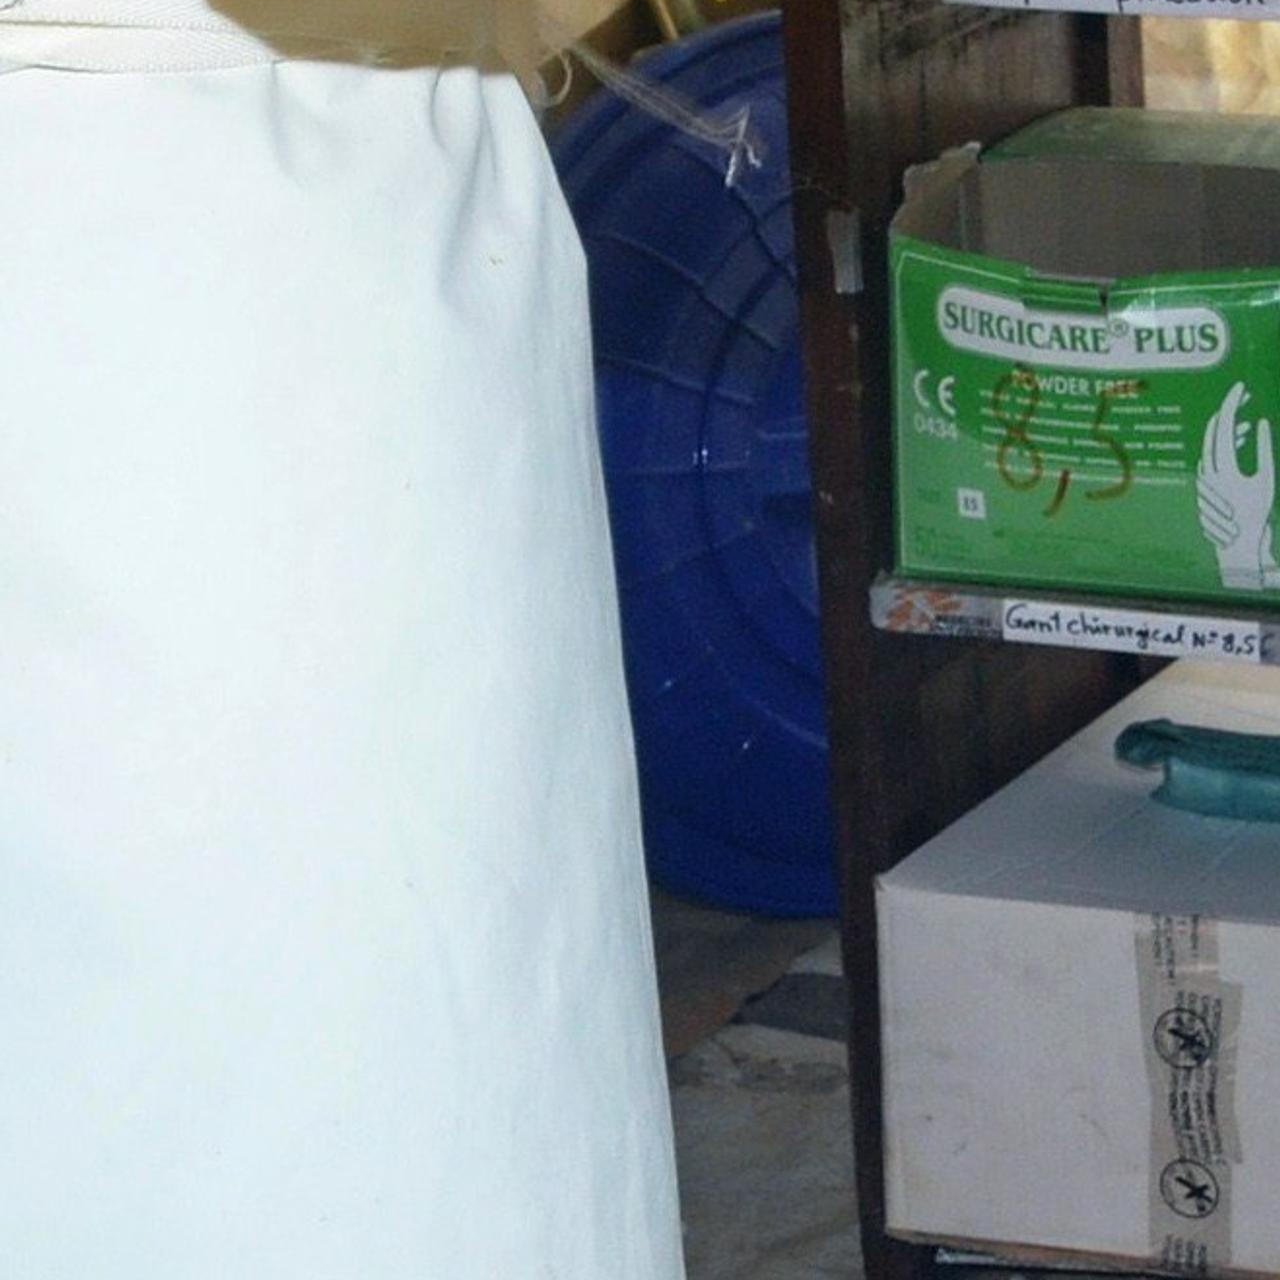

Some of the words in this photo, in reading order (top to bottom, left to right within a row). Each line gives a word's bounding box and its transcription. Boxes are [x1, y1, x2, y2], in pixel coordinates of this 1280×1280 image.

[1134, 321, 1220, 355] PLUS
[1012, 369, 1091, 396] POWDER
[1005, 602, 1061, 630] Gant
